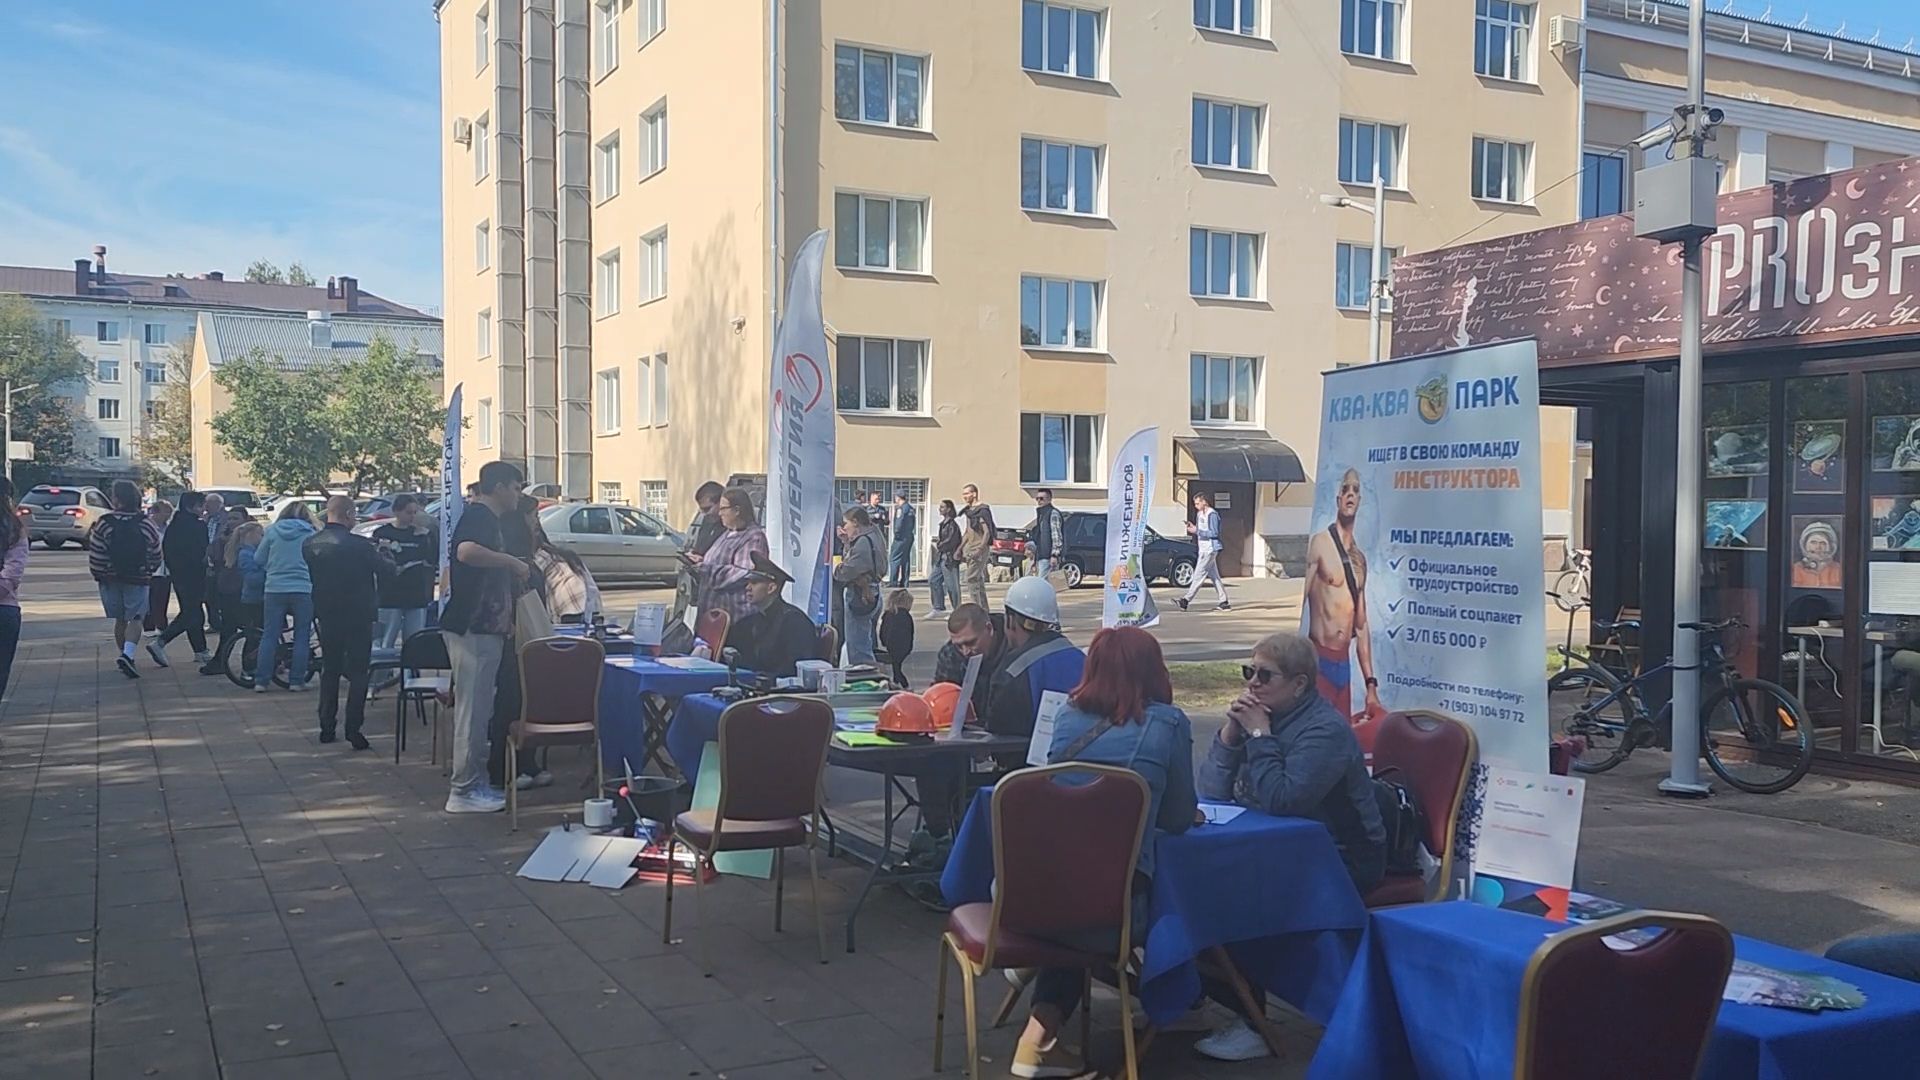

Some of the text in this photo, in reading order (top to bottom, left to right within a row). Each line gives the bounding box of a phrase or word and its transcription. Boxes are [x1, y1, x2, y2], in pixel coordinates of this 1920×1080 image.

[1455, 375, 1520, 410] ПАРК
[1368, 441, 1520, 464] ИЩЕТ В СВОЮ КОМАНДУ
[1393, 468, 1520, 490] ИНСТРУКТОРА
[1390, 529, 1514, 548] МЫ ПРЕДЛАГАЕМ:
[1408, 558, 1498, 577] Официальное
[1407, 577, 1519, 596] трудоустройство
[1407, 600, 1522, 625] Полный соцпакет
[1432, 630, 1446, 645] 65
[1449, 632, 1477, 648] 000
[1387, 673, 1525, 704] Подробности по телефону:
[1438, 699, 1450, 710] +7
[1451, 700, 1478, 715] (903)
[1480, 706, 1498, 718] 104
[1512, 710, 1525, 723] 72
